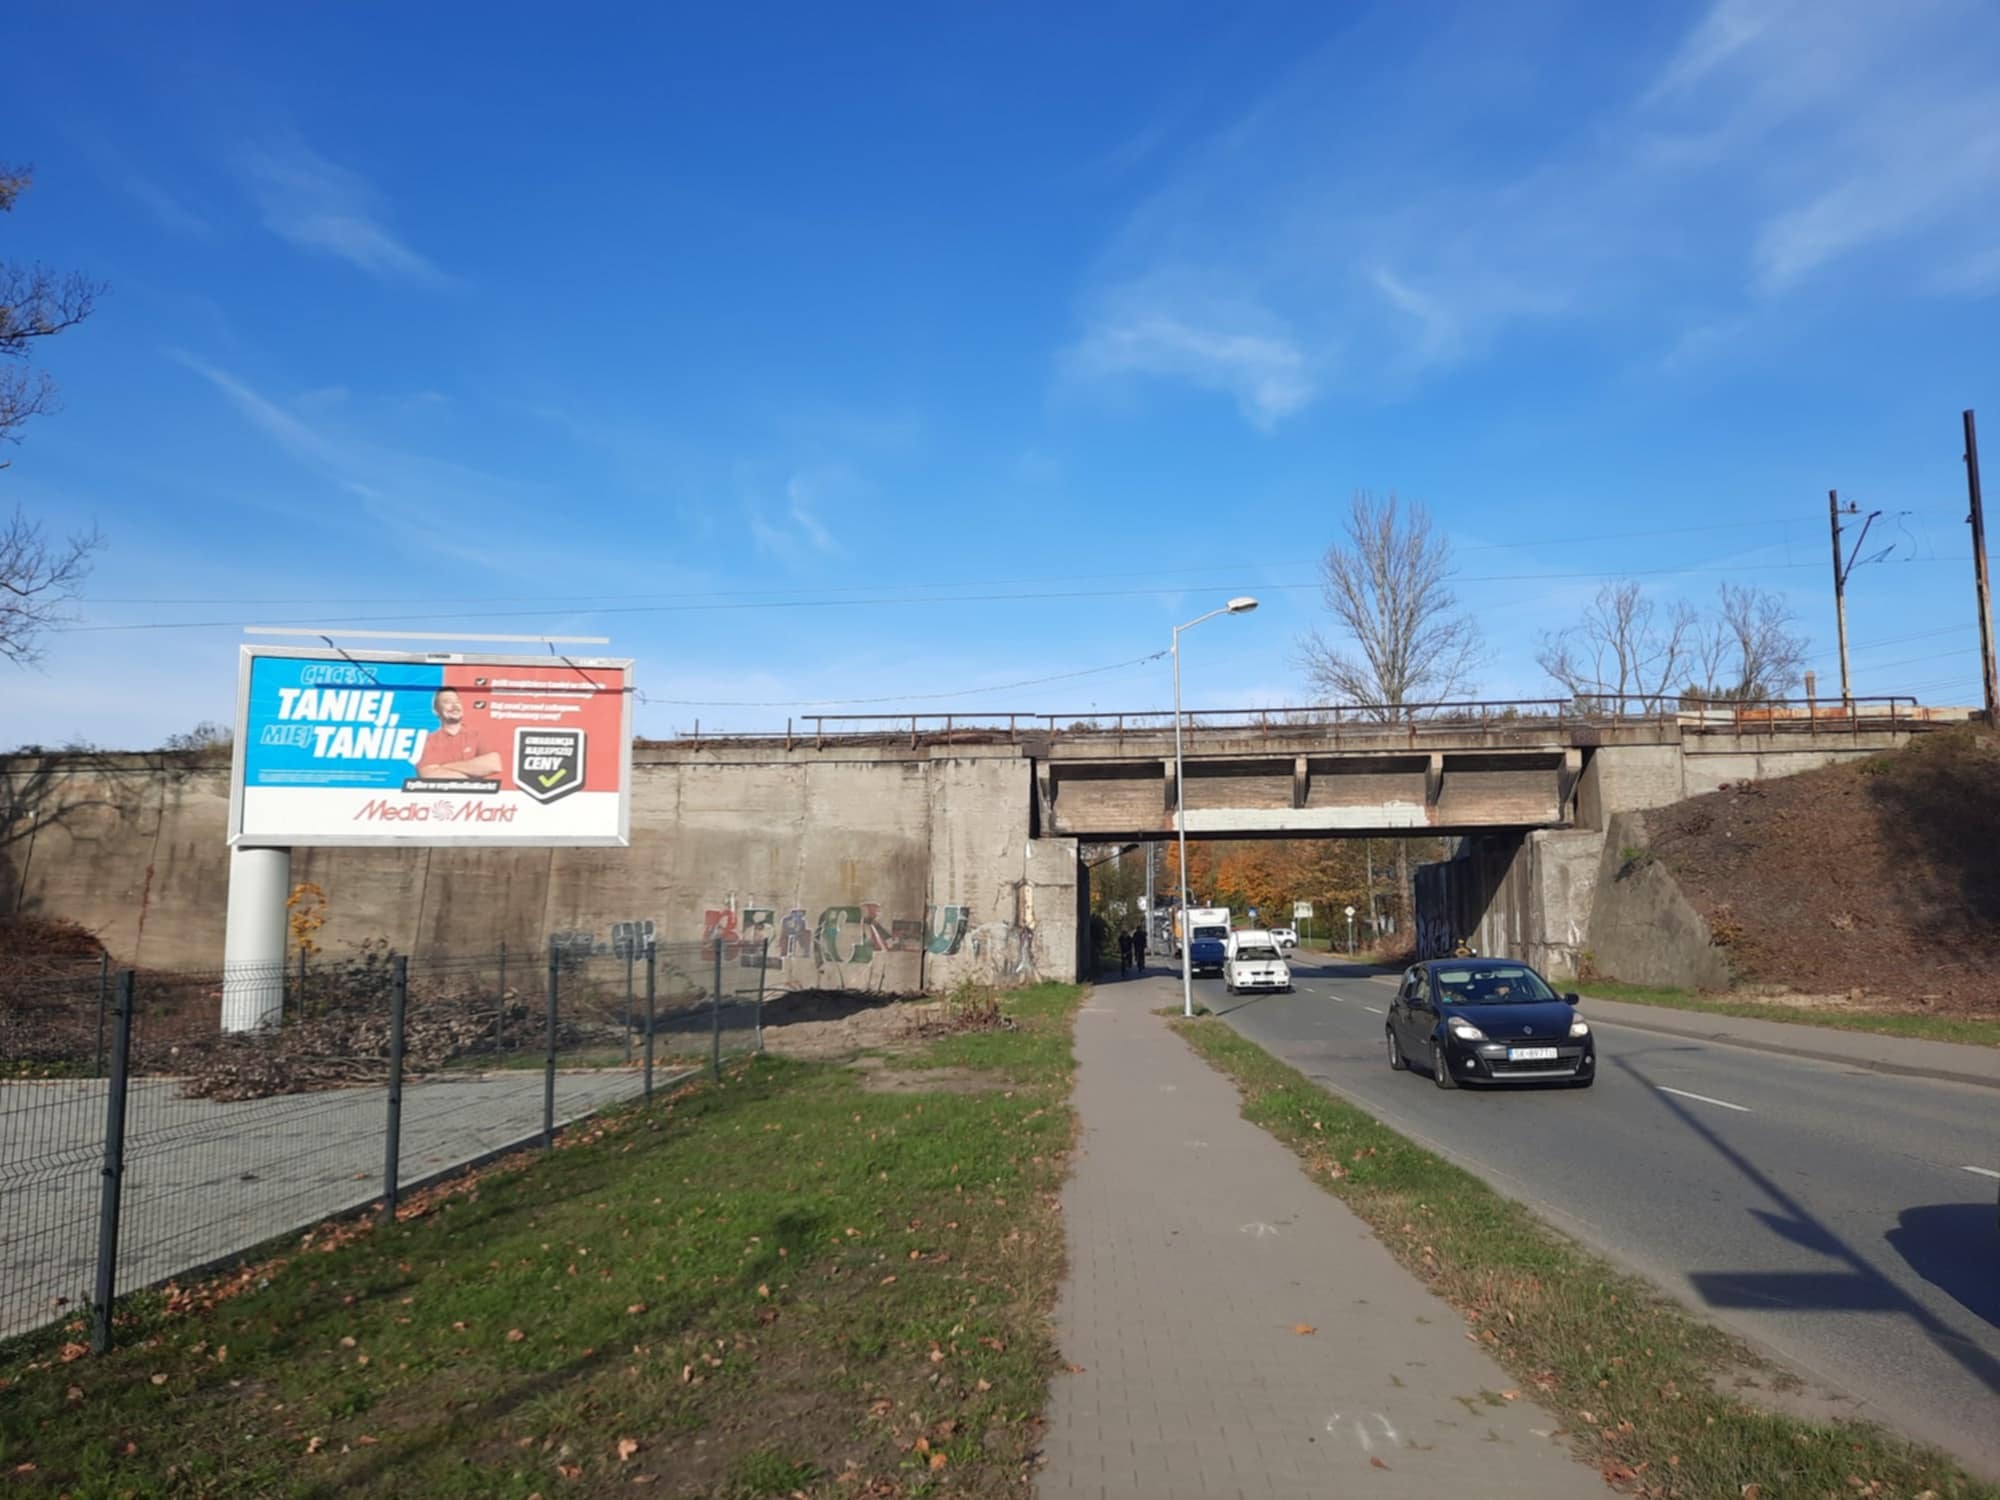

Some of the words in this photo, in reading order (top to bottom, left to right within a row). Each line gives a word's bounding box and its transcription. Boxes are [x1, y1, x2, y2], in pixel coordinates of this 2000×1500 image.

[302, 665, 378, 685] CHCESZ
[278, 688, 399, 726] TANIEJ,
[260, 724, 313, 748] MIEJ
[313, 726, 429, 765] TANIEJ
[523, 757, 562, 771] CENY
[353, 799, 430, 821] Media
[450, 800, 518, 822] Markt
